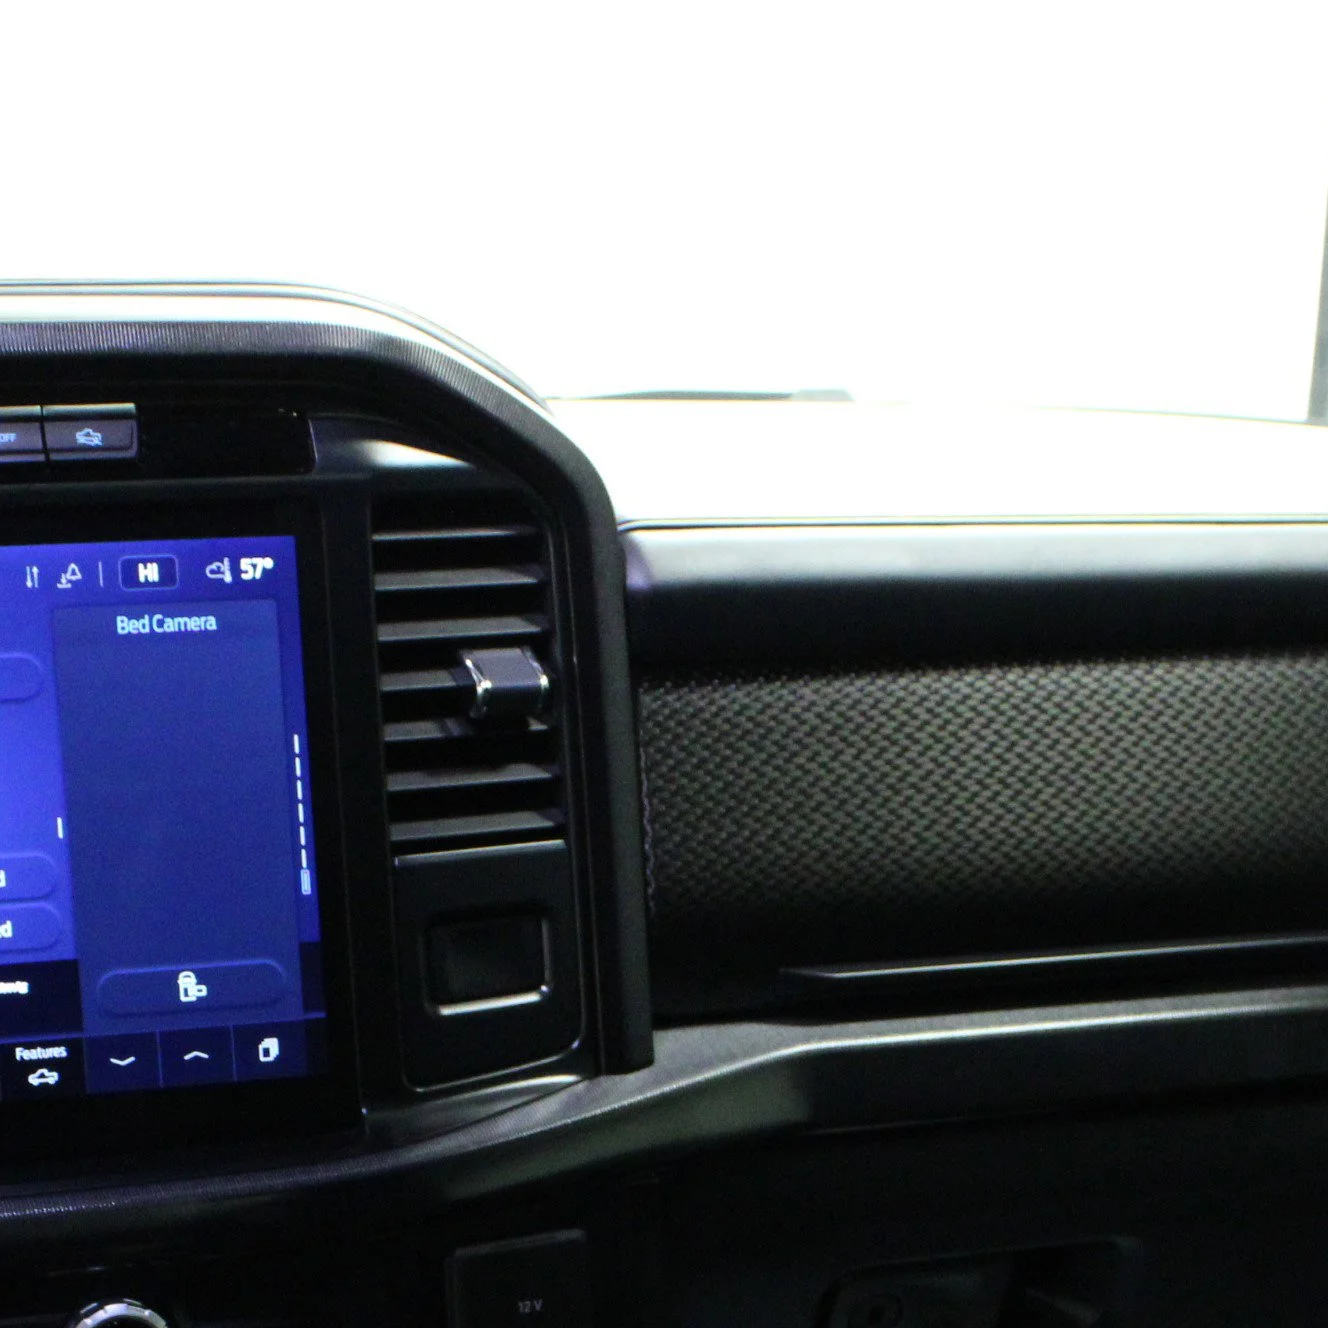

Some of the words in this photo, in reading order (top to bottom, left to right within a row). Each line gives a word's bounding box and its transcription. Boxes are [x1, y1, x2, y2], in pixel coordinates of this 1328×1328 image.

[137, 562, 159, 582] HI
[239, 556, 274, 580] 57°
[116, 614, 150, 635] Bed
[152, 612, 217, 633] Camera
[15, 1045, 68, 1062] Features
